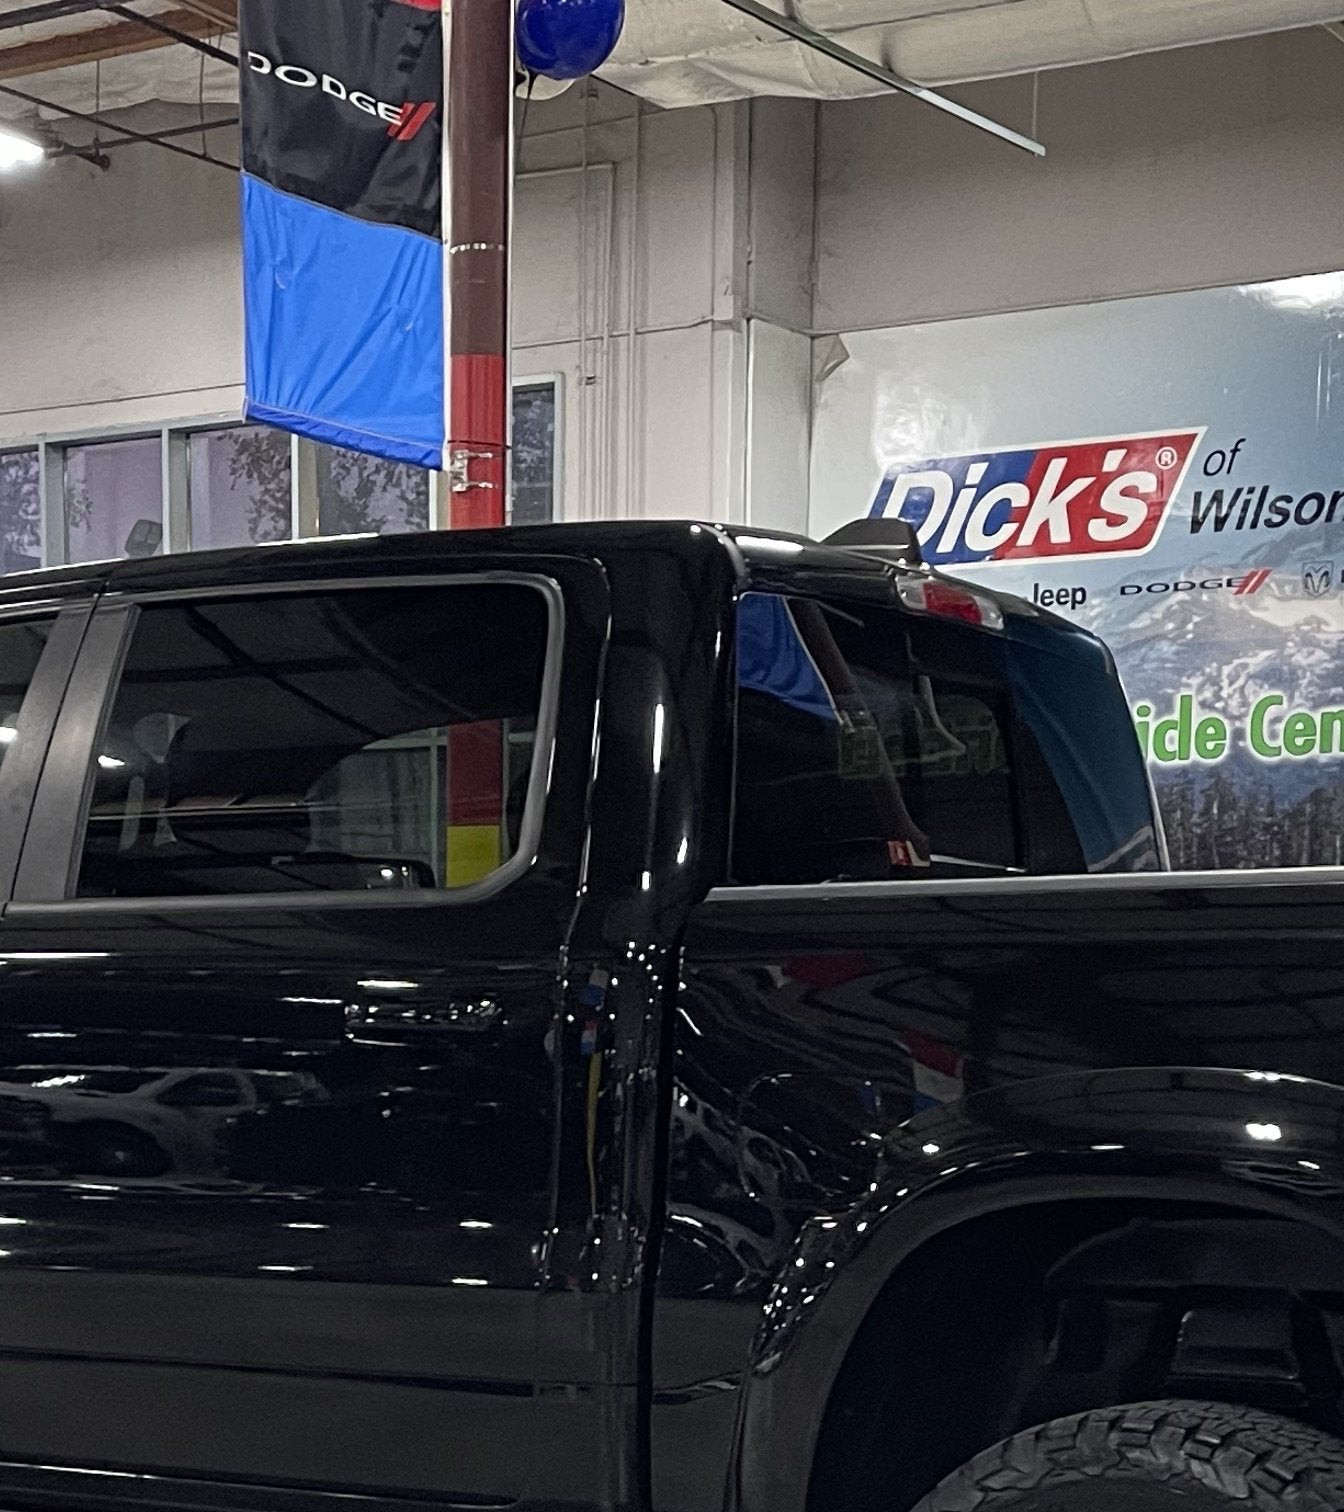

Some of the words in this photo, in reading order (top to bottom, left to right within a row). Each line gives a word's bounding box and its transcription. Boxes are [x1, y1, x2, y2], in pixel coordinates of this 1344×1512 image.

[247, 50, 405, 127] DODGE
[1202, 437, 1246, 477] of
[881, 448, 1158, 554] Dick's
[1119, 576, 1248, 596] DODGE
